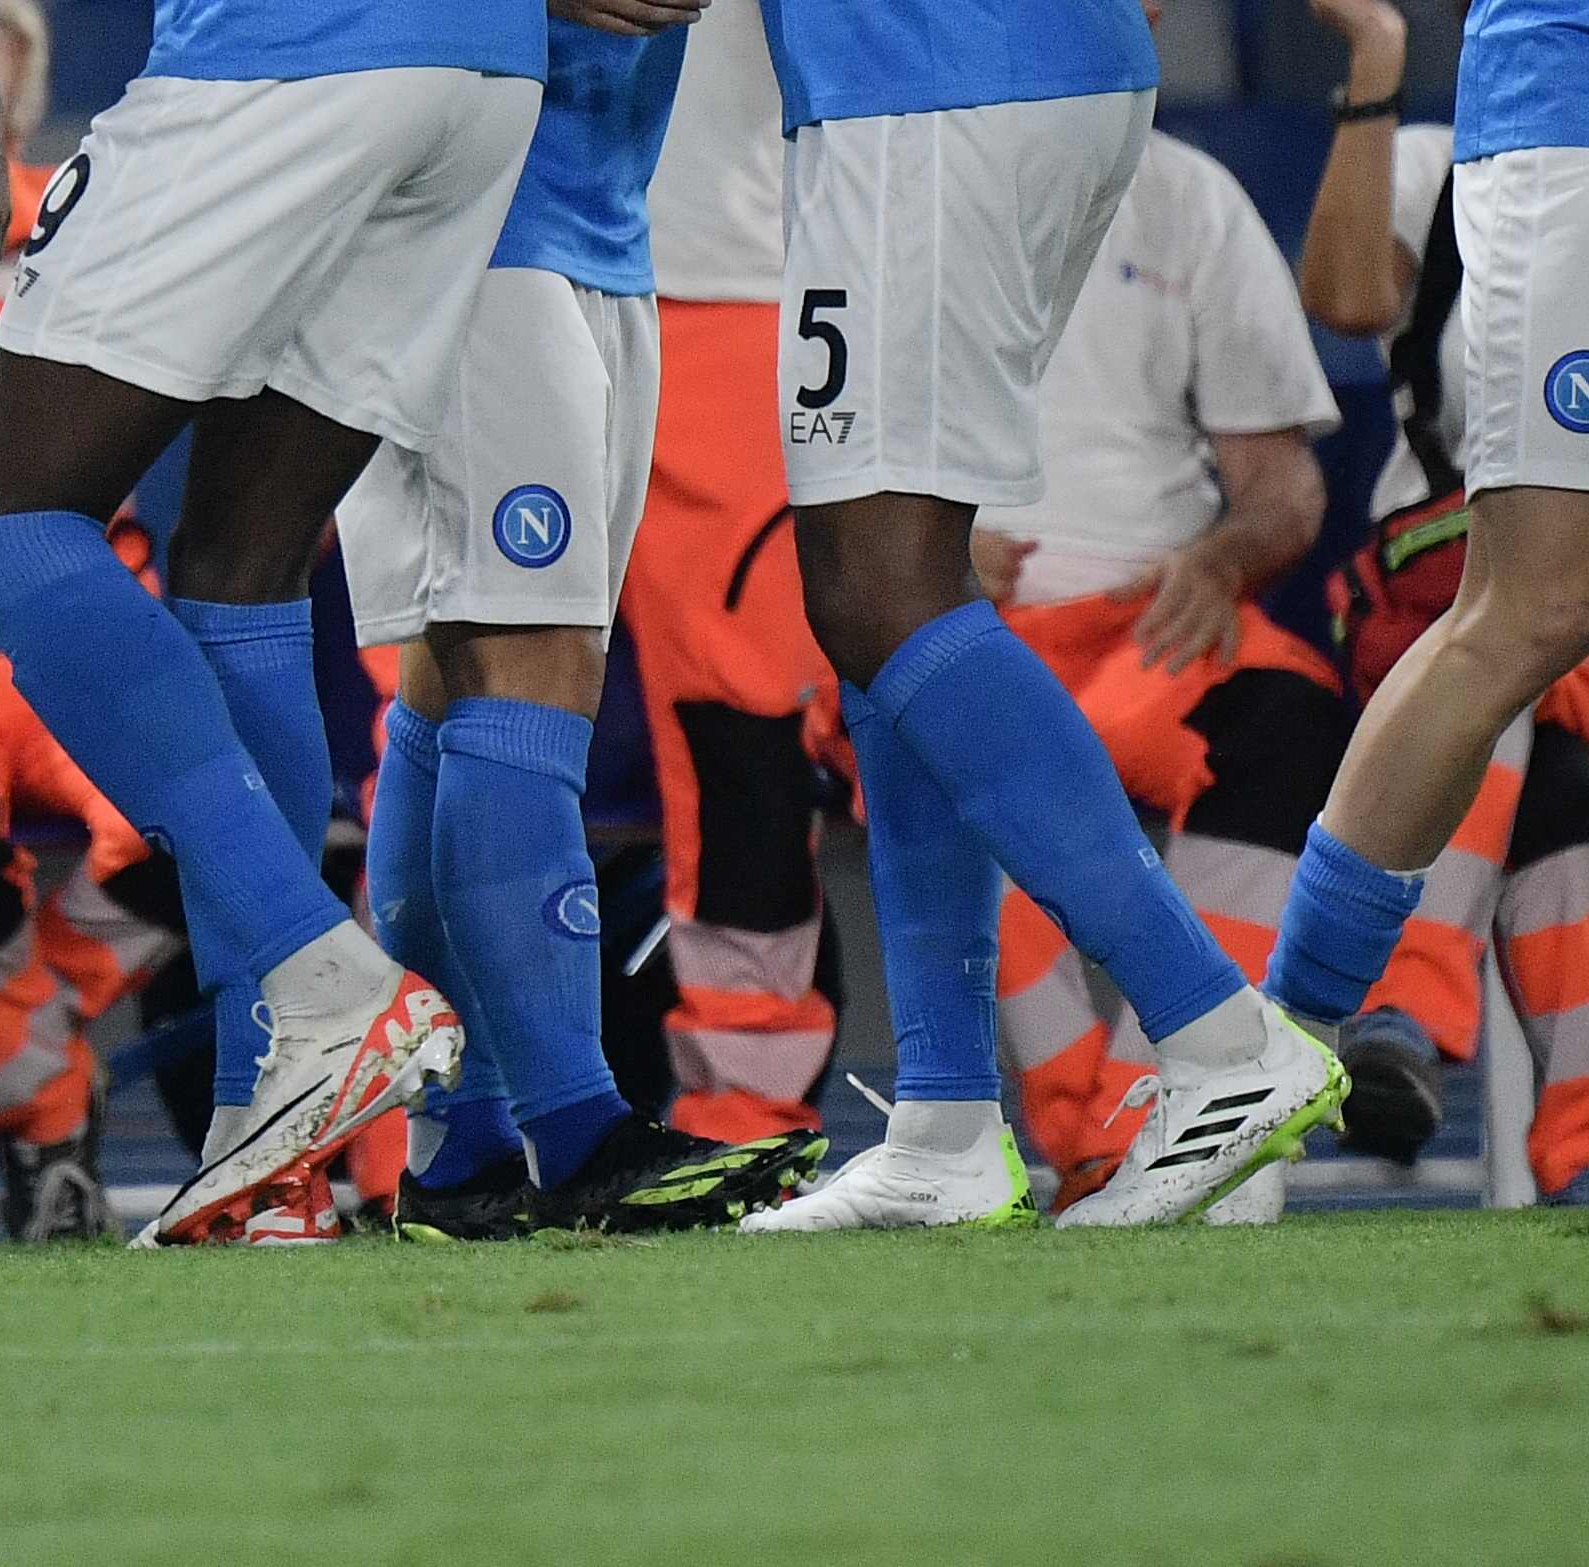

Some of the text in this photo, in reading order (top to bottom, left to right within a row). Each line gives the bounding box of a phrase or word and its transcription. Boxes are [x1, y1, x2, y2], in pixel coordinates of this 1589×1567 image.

[25, 152, 91, 257] 9
[796, 288, 849, 410] 5
[791, 411, 857, 445] EA7
[517, 508, 552, 545] N
